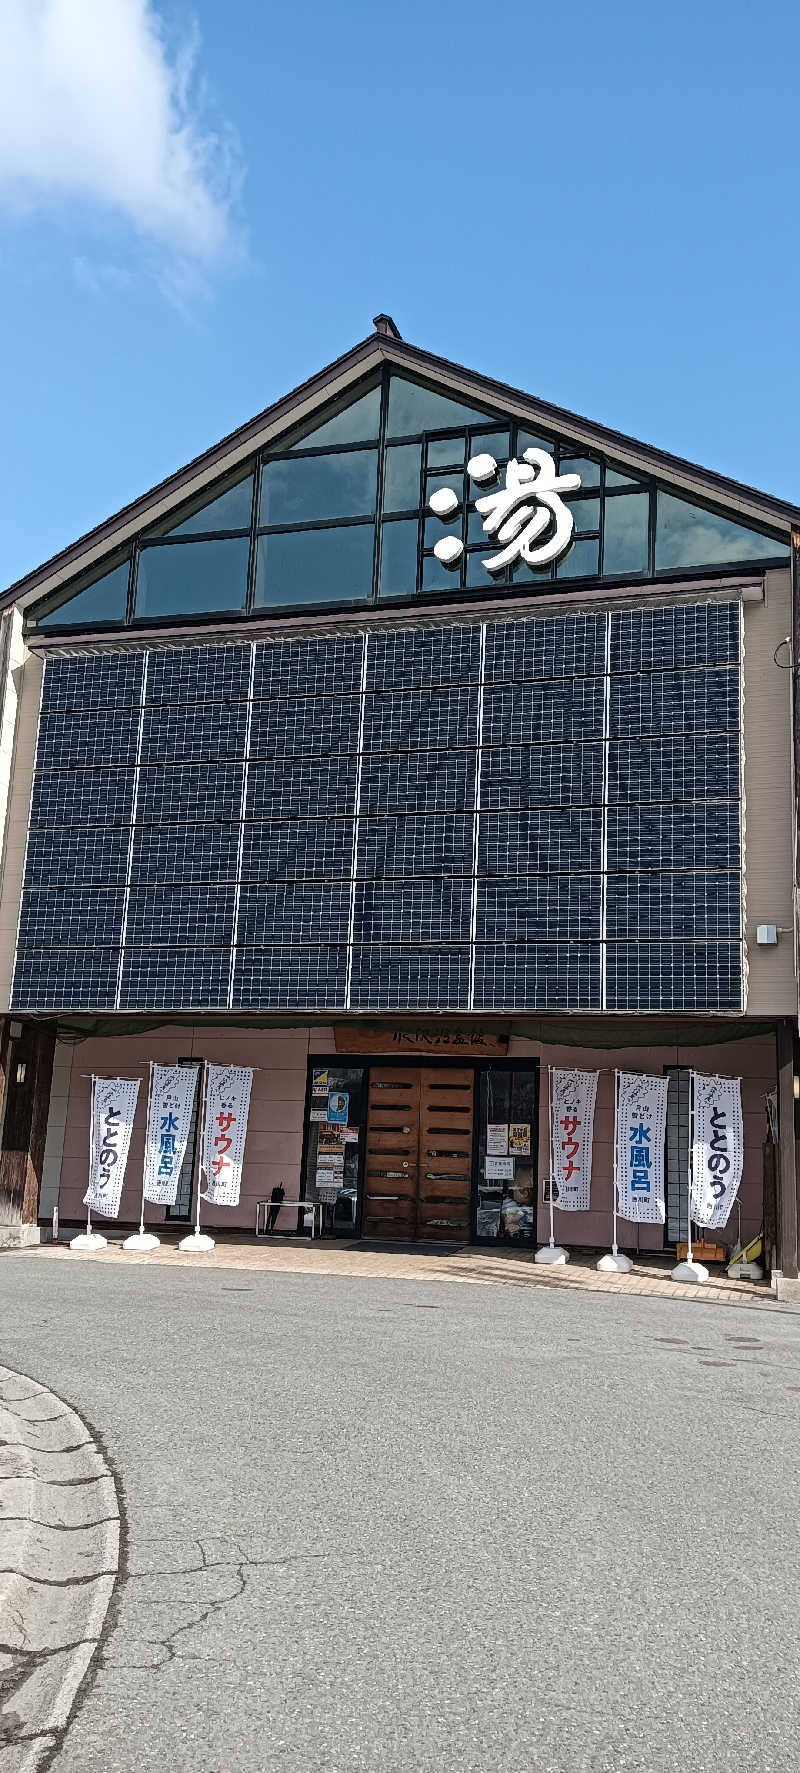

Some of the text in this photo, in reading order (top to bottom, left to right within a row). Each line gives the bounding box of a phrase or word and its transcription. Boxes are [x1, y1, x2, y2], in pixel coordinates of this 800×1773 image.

[428, 447, 581, 571] 湯
[99, 1106, 122, 1189] ととのう
[157, 1111, 180, 1177] 水風呂
[211, 1111, 237, 1177] サウナ
[559, 1115, 582, 1182] サウナ
[628, 1122, 653, 1193] 水風呂
[707, 1106, 731, 1200] ととのう
